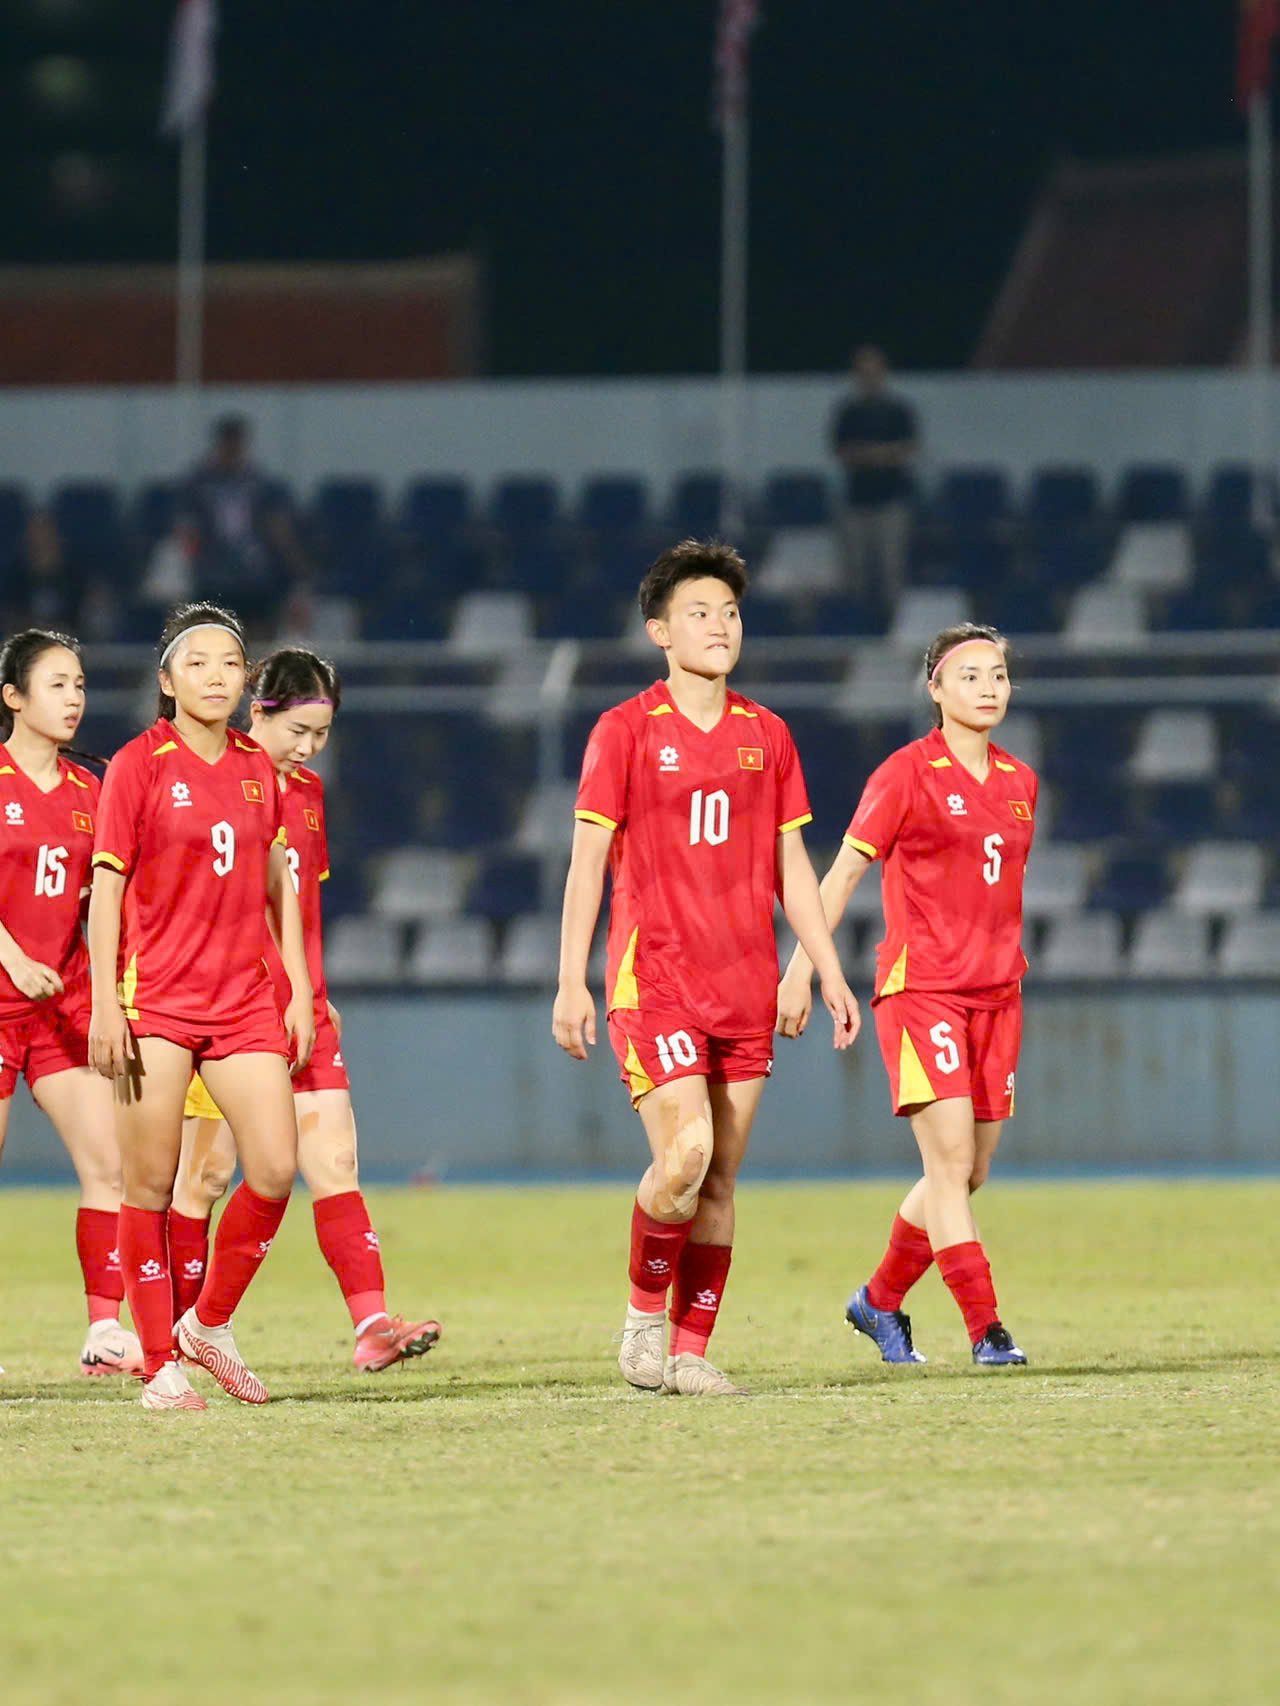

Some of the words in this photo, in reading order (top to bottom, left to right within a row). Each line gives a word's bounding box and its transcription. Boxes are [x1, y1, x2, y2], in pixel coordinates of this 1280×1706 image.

[689, 789, 730, 846] 10
[34, 844, 69, 898] 15
[210, 820, 235, 877] 9
[983, 832, 1005, 886] 5
[655, 1029, 698, 1075] 10
[929, 1020, 961, 1075] 5
